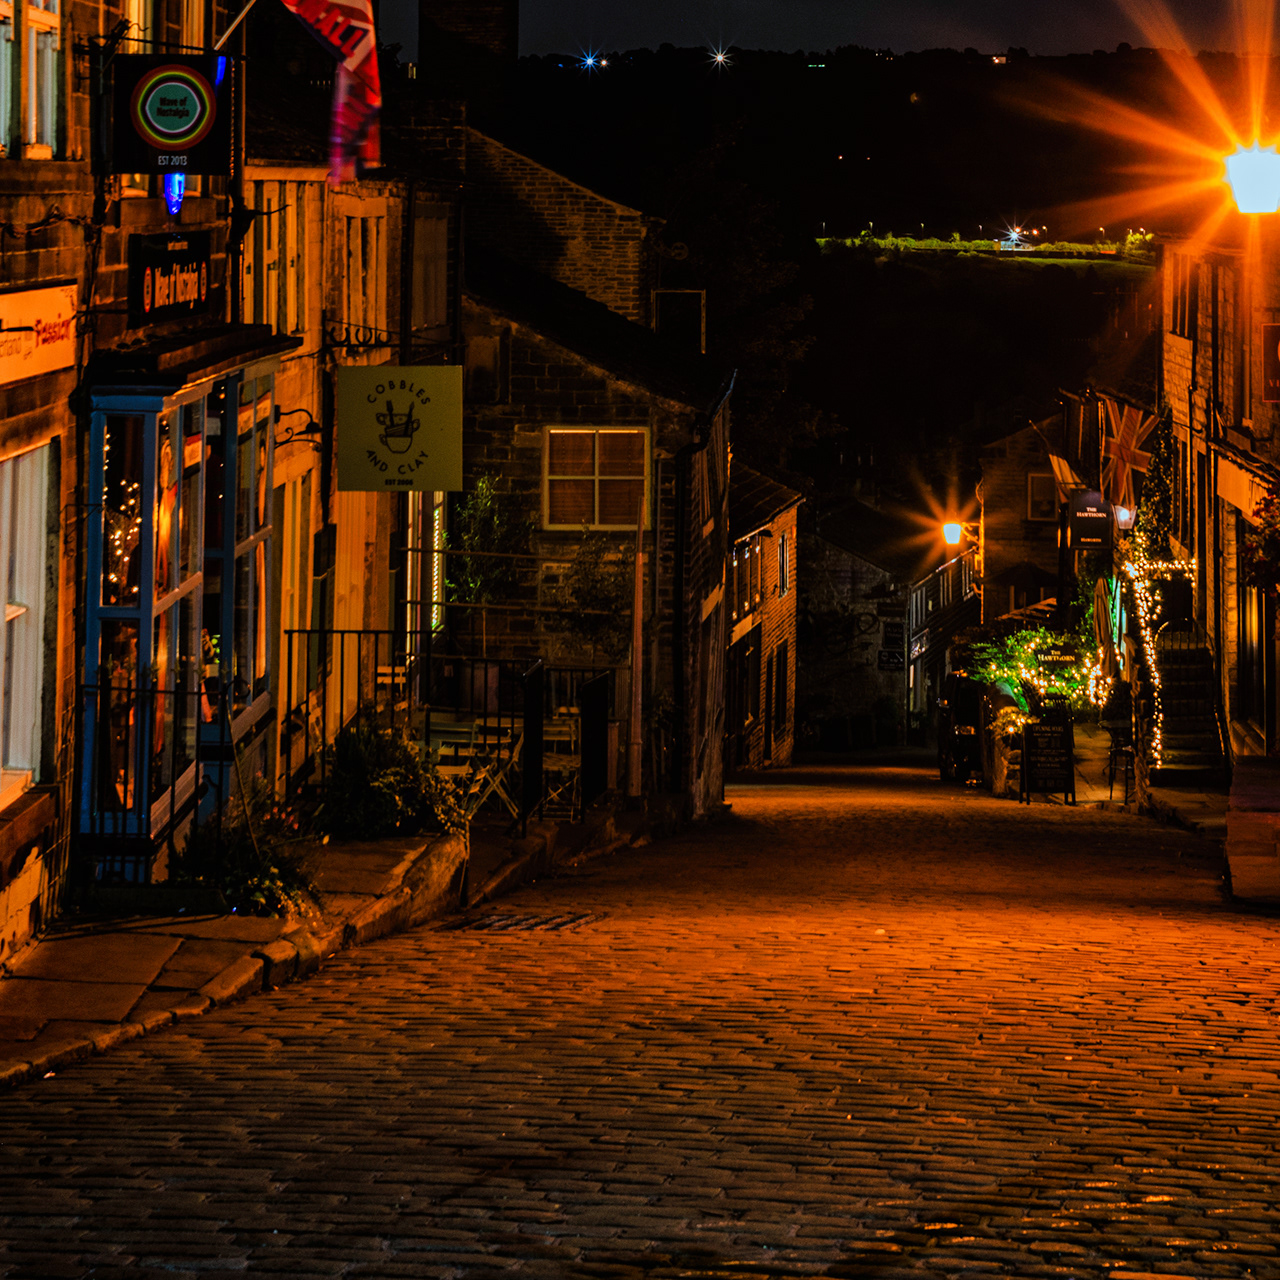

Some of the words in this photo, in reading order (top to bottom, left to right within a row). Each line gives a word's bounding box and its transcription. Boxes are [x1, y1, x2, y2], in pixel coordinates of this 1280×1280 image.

[160, 98, 178, 107] Wave
[180, 97, 188, 107] of
[156, 107, 190, 119] Nostalgia
[157, 155, 169, 166] EST
[170, 155, 188, 166] 2013
[154, 267, 170, 309] Wave
[175, 261, 199, 310] Nostalgia
[367, 380, 431, 405] COBBLES
[366, 450, 388, 472] AND
[397, 451, 429, 475] CLAY
